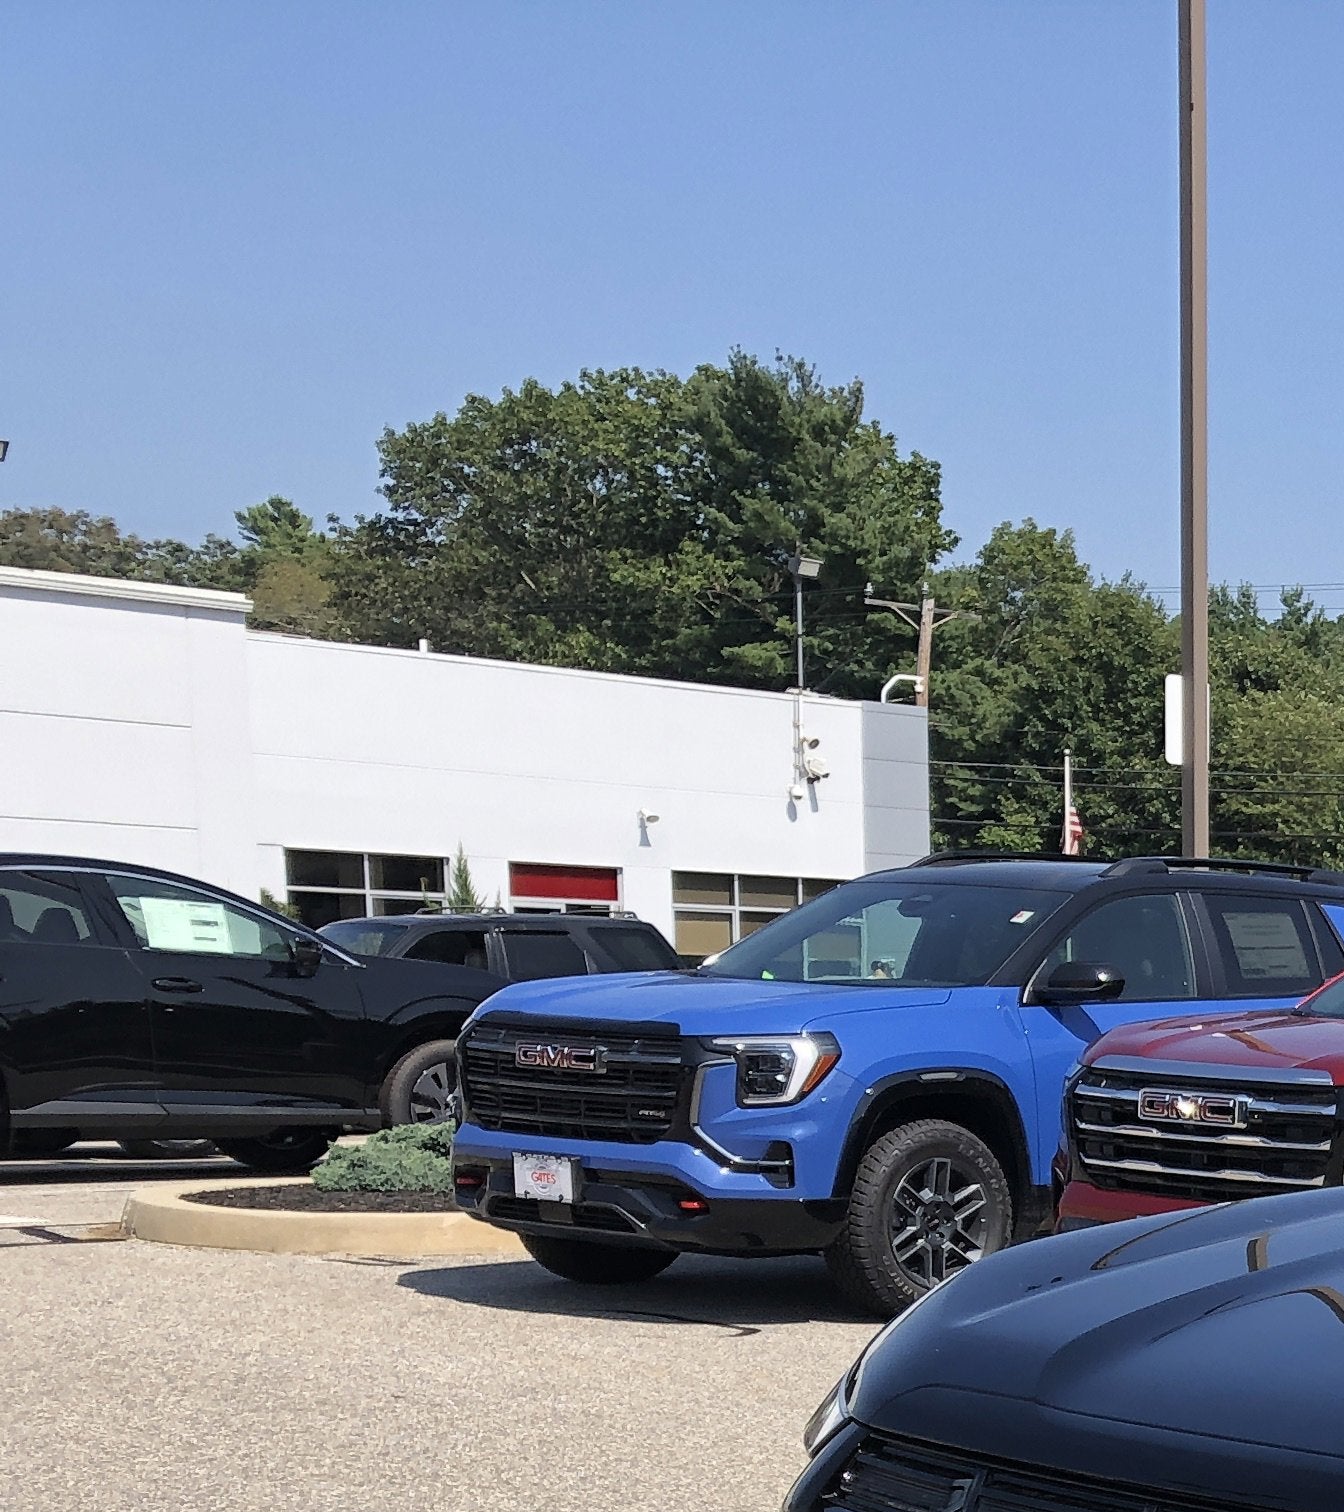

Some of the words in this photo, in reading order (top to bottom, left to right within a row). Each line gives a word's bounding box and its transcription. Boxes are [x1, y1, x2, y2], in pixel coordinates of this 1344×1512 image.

[517, 1044, 594, 1070] GMC
[1140, 1093, 1235, 1123] GMC
[531, 1172, 556, 1184] GATES
